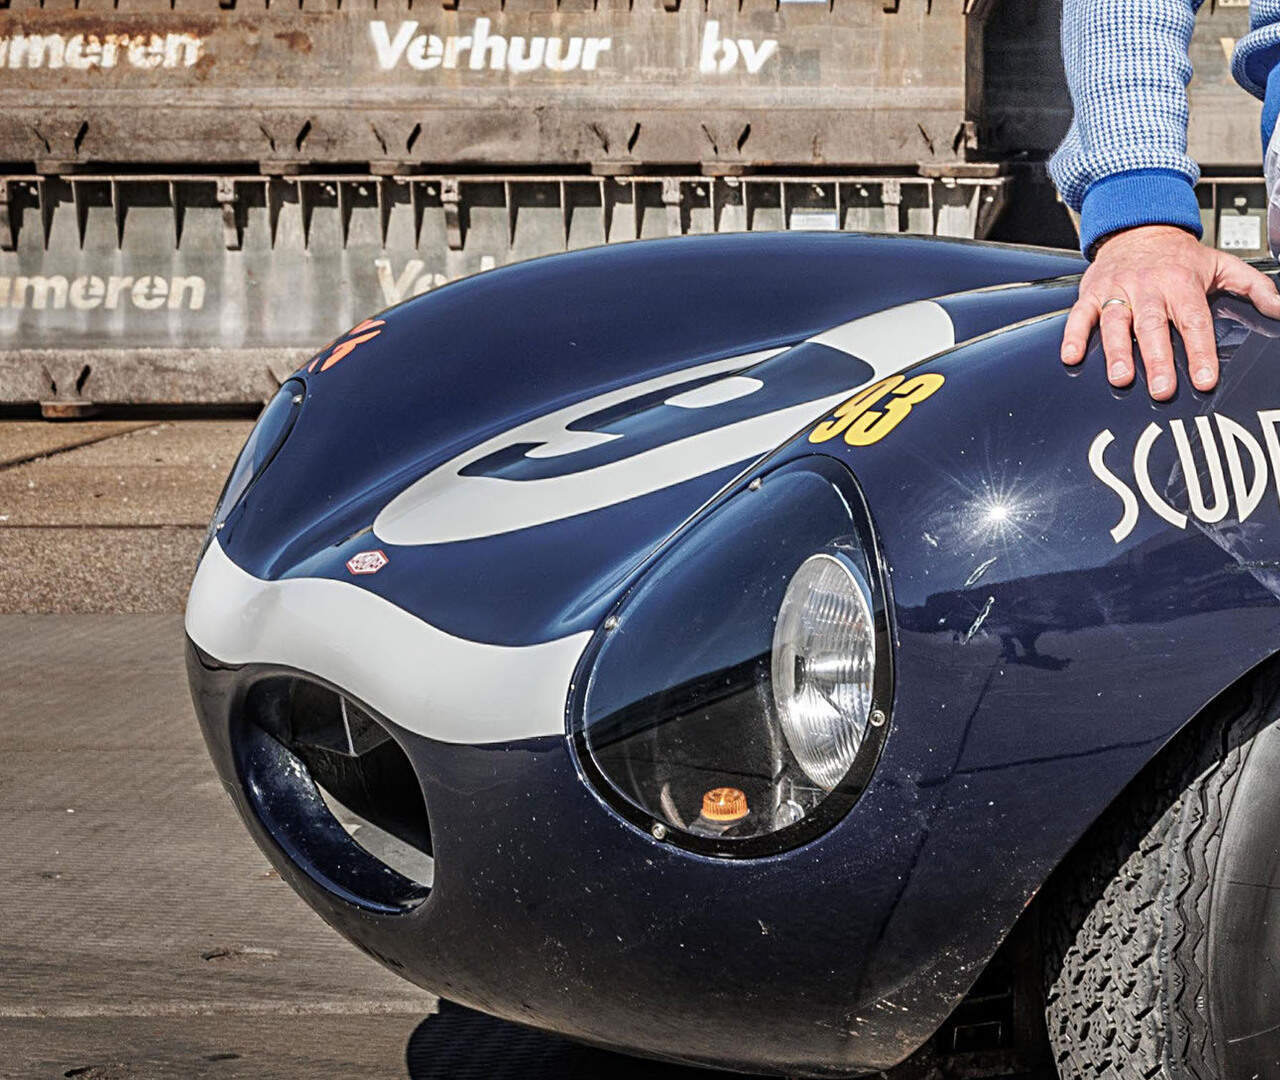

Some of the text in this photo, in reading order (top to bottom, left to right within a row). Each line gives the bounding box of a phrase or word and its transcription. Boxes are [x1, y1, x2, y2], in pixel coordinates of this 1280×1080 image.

[369, 18, 613, 74] Verhuur
[700, 20, 780, 75] bv
[809, 373, 946, 447] 93
